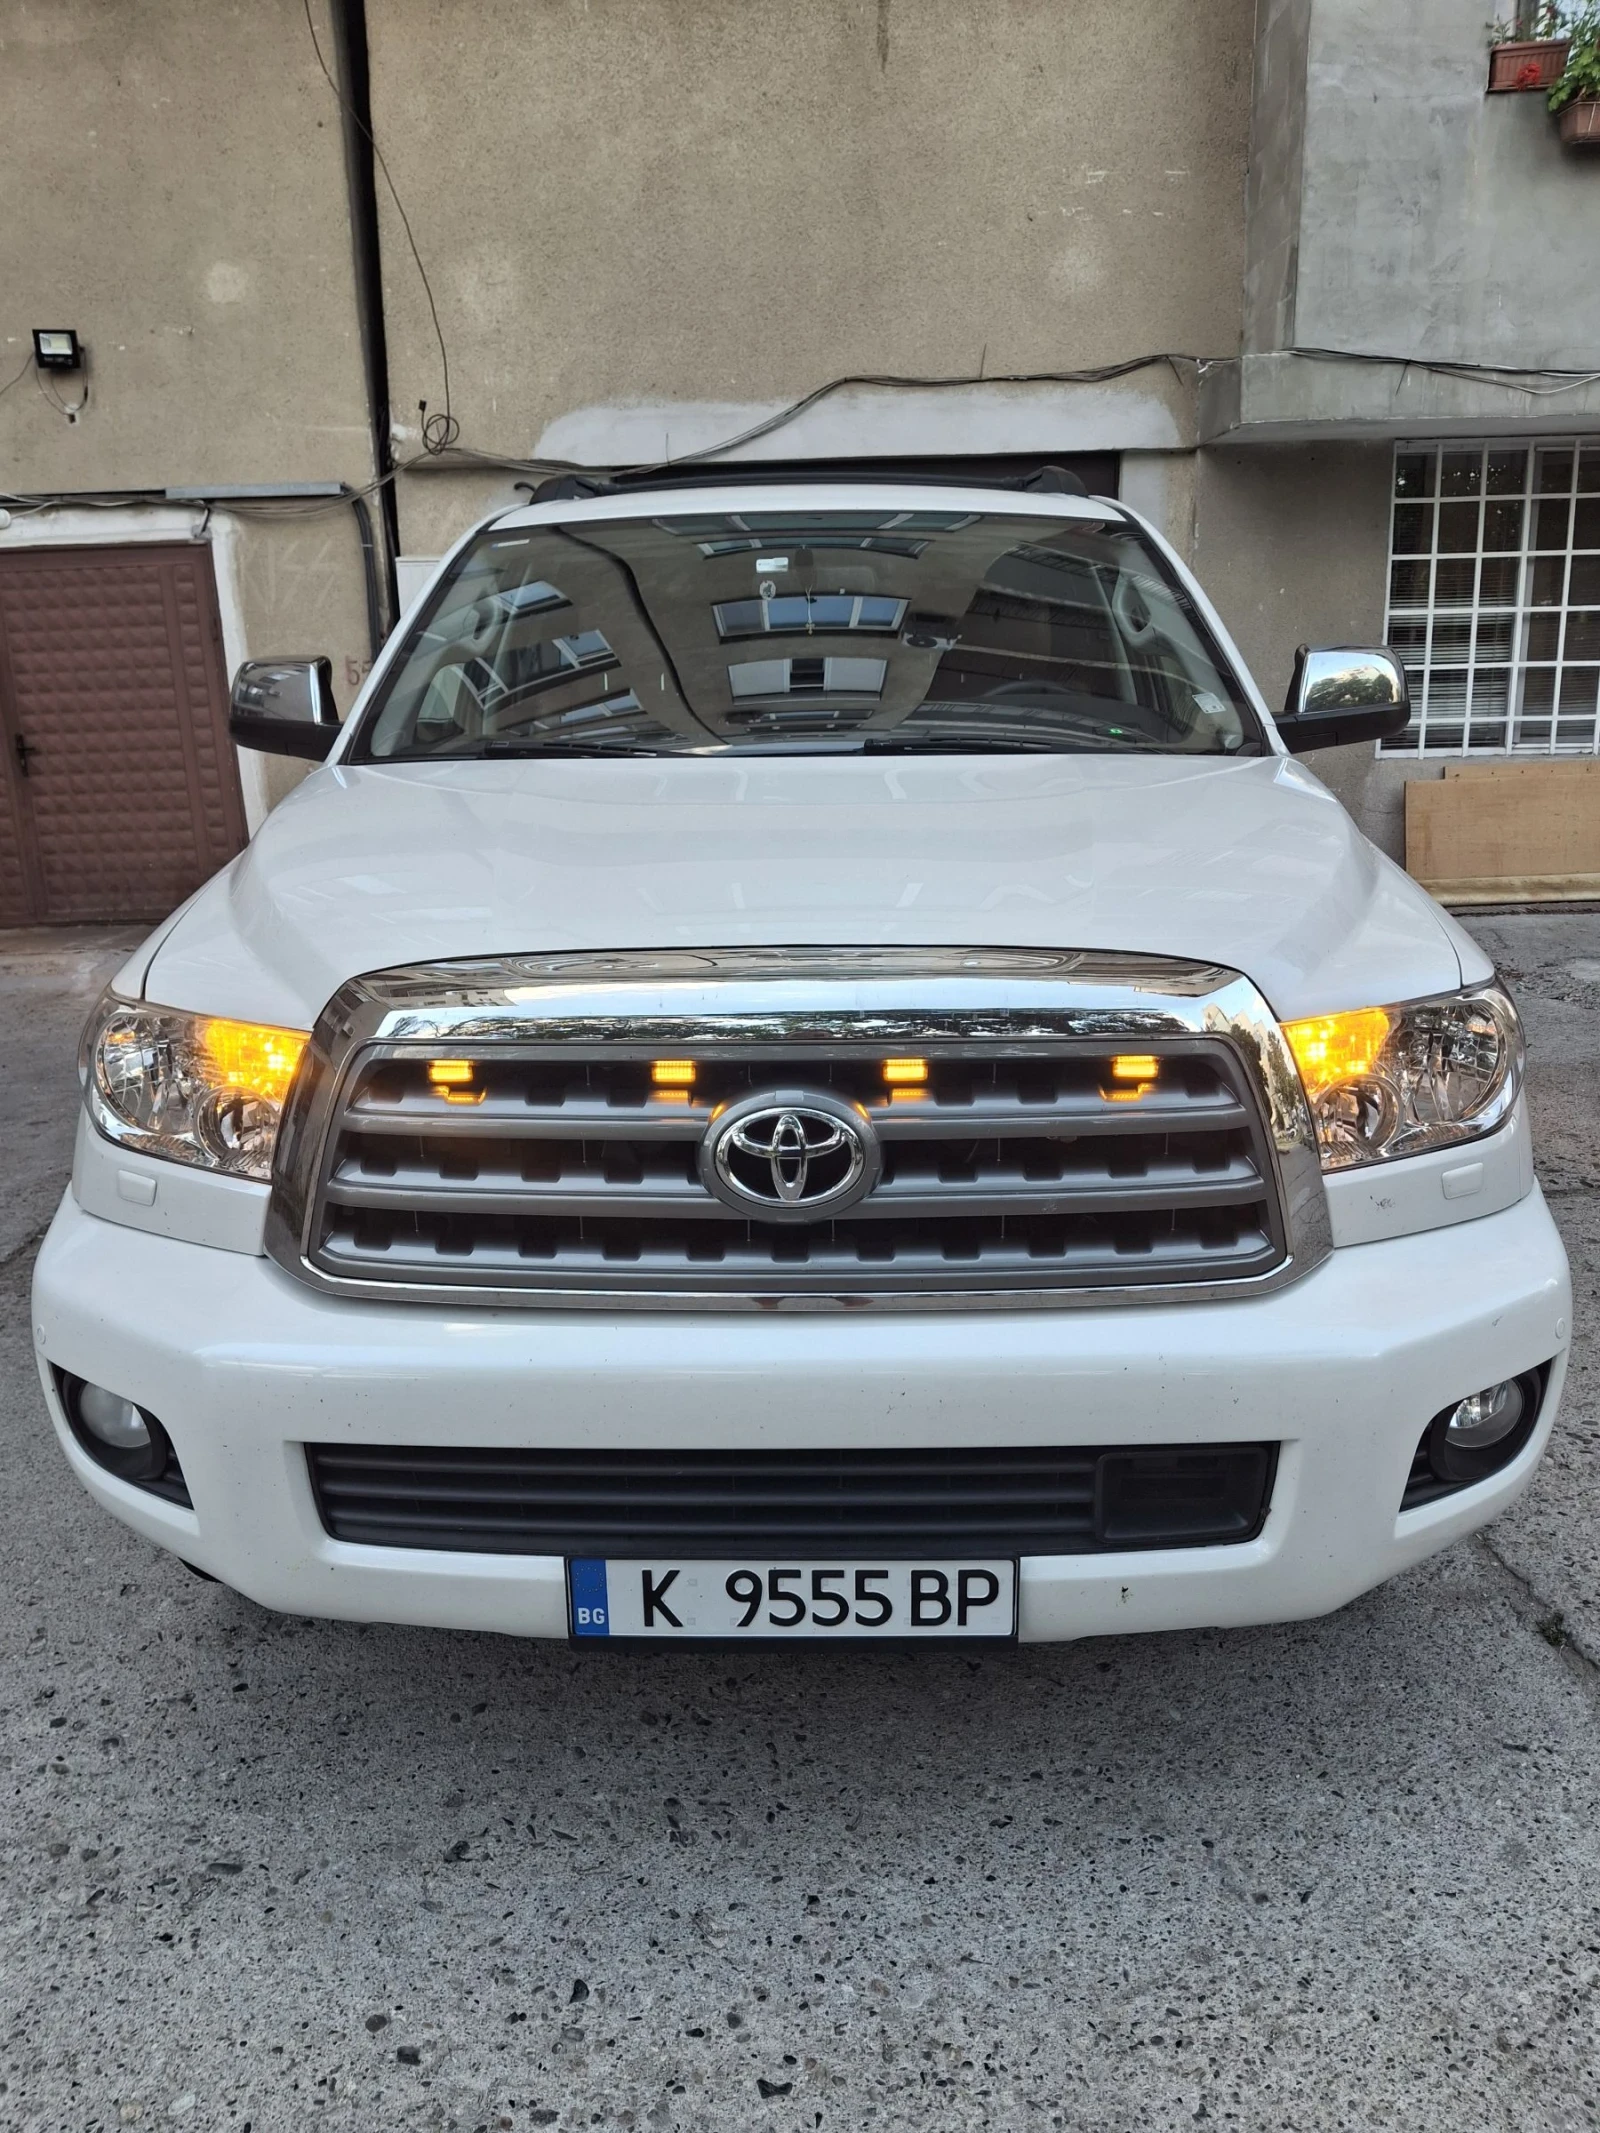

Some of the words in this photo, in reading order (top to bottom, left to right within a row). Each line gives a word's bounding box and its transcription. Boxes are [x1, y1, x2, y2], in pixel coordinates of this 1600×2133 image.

[577, 1607, 605, 1625] BG
[641, 1569, 684, 1628] K
[725, 1569, 893, 1627] 9555
[910, 1569, 999, 1627] BP
